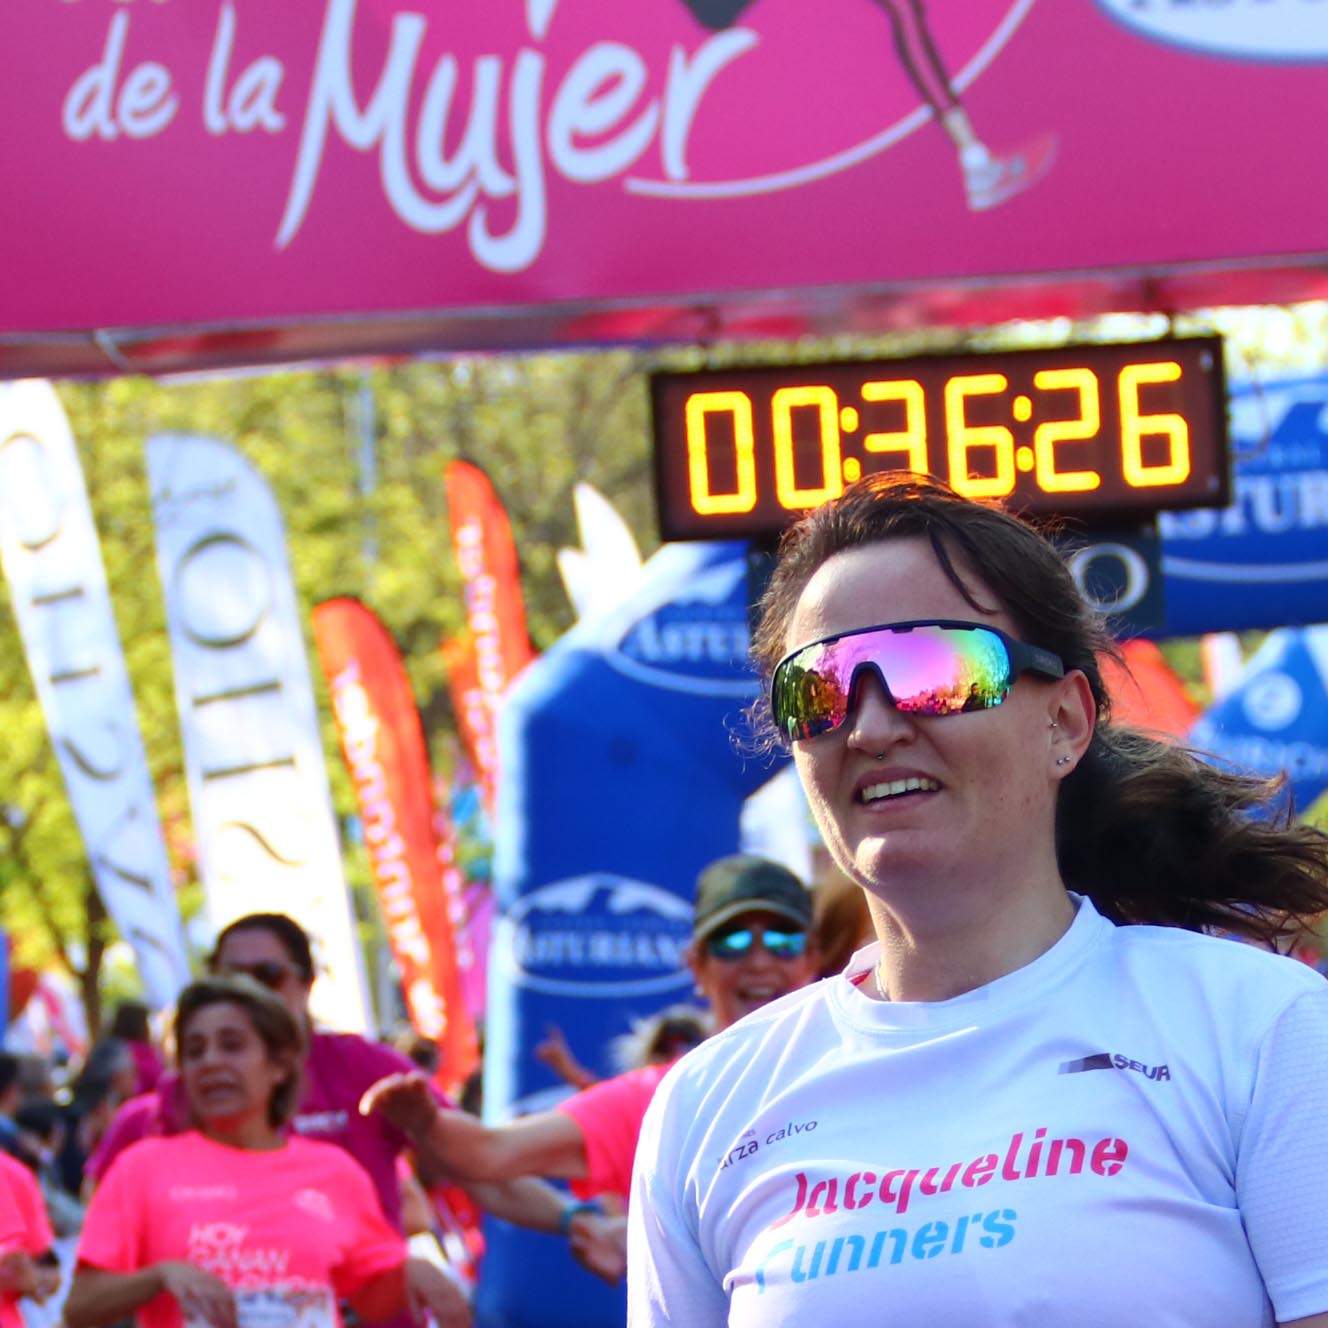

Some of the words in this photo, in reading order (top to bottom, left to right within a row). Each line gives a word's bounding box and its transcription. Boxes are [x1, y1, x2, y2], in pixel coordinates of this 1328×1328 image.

[64, 10, 178, 140] de
[205, 2, 285, 134] la
[276, 0, 758, 273] Mujer
[685, 360, 1190, 516] 00:36:26
[765, 1120, 819, 1146] calvo
[772, 1127, 1129, 1230] Jacqueline
